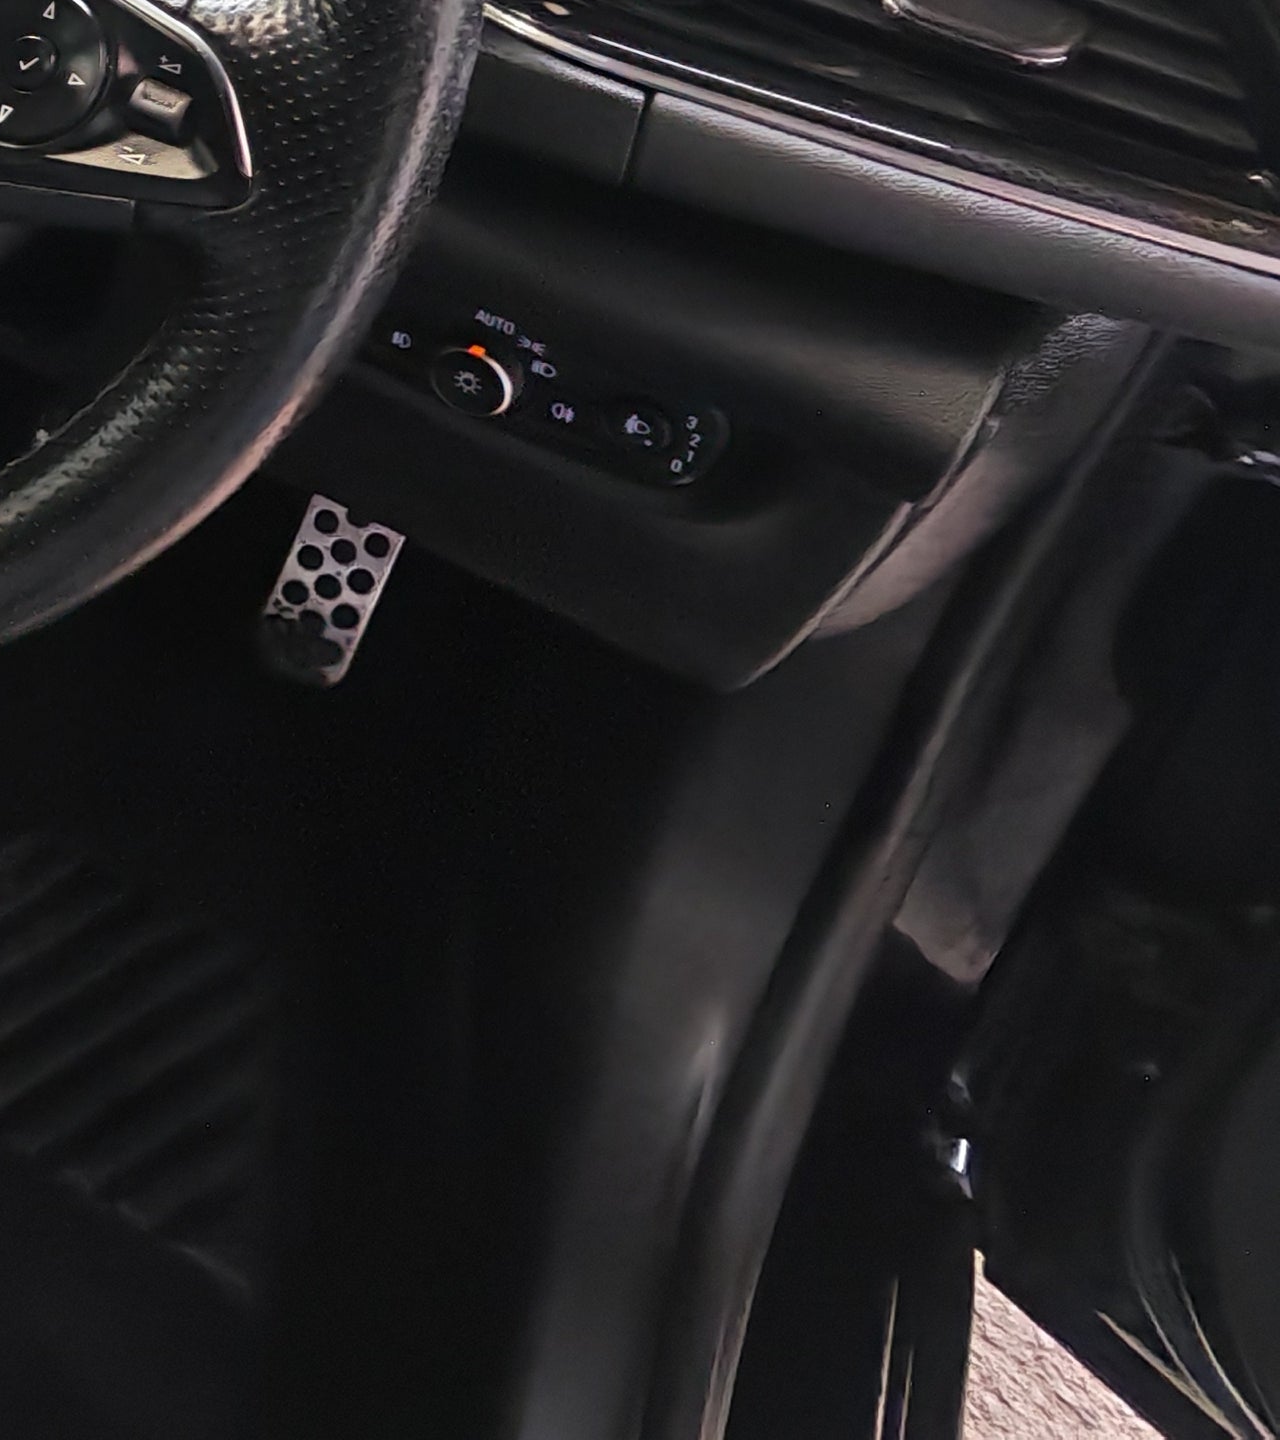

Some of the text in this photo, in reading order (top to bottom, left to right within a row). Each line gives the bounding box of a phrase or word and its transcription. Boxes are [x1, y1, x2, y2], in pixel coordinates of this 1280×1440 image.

[474, 309, 516, 335] AUTO
[686, 415, 699, 429] 3
[688, 433, 701, 448] 2
[686, 449, 695, 462] 1
[670, 458, 683, 473] 0
